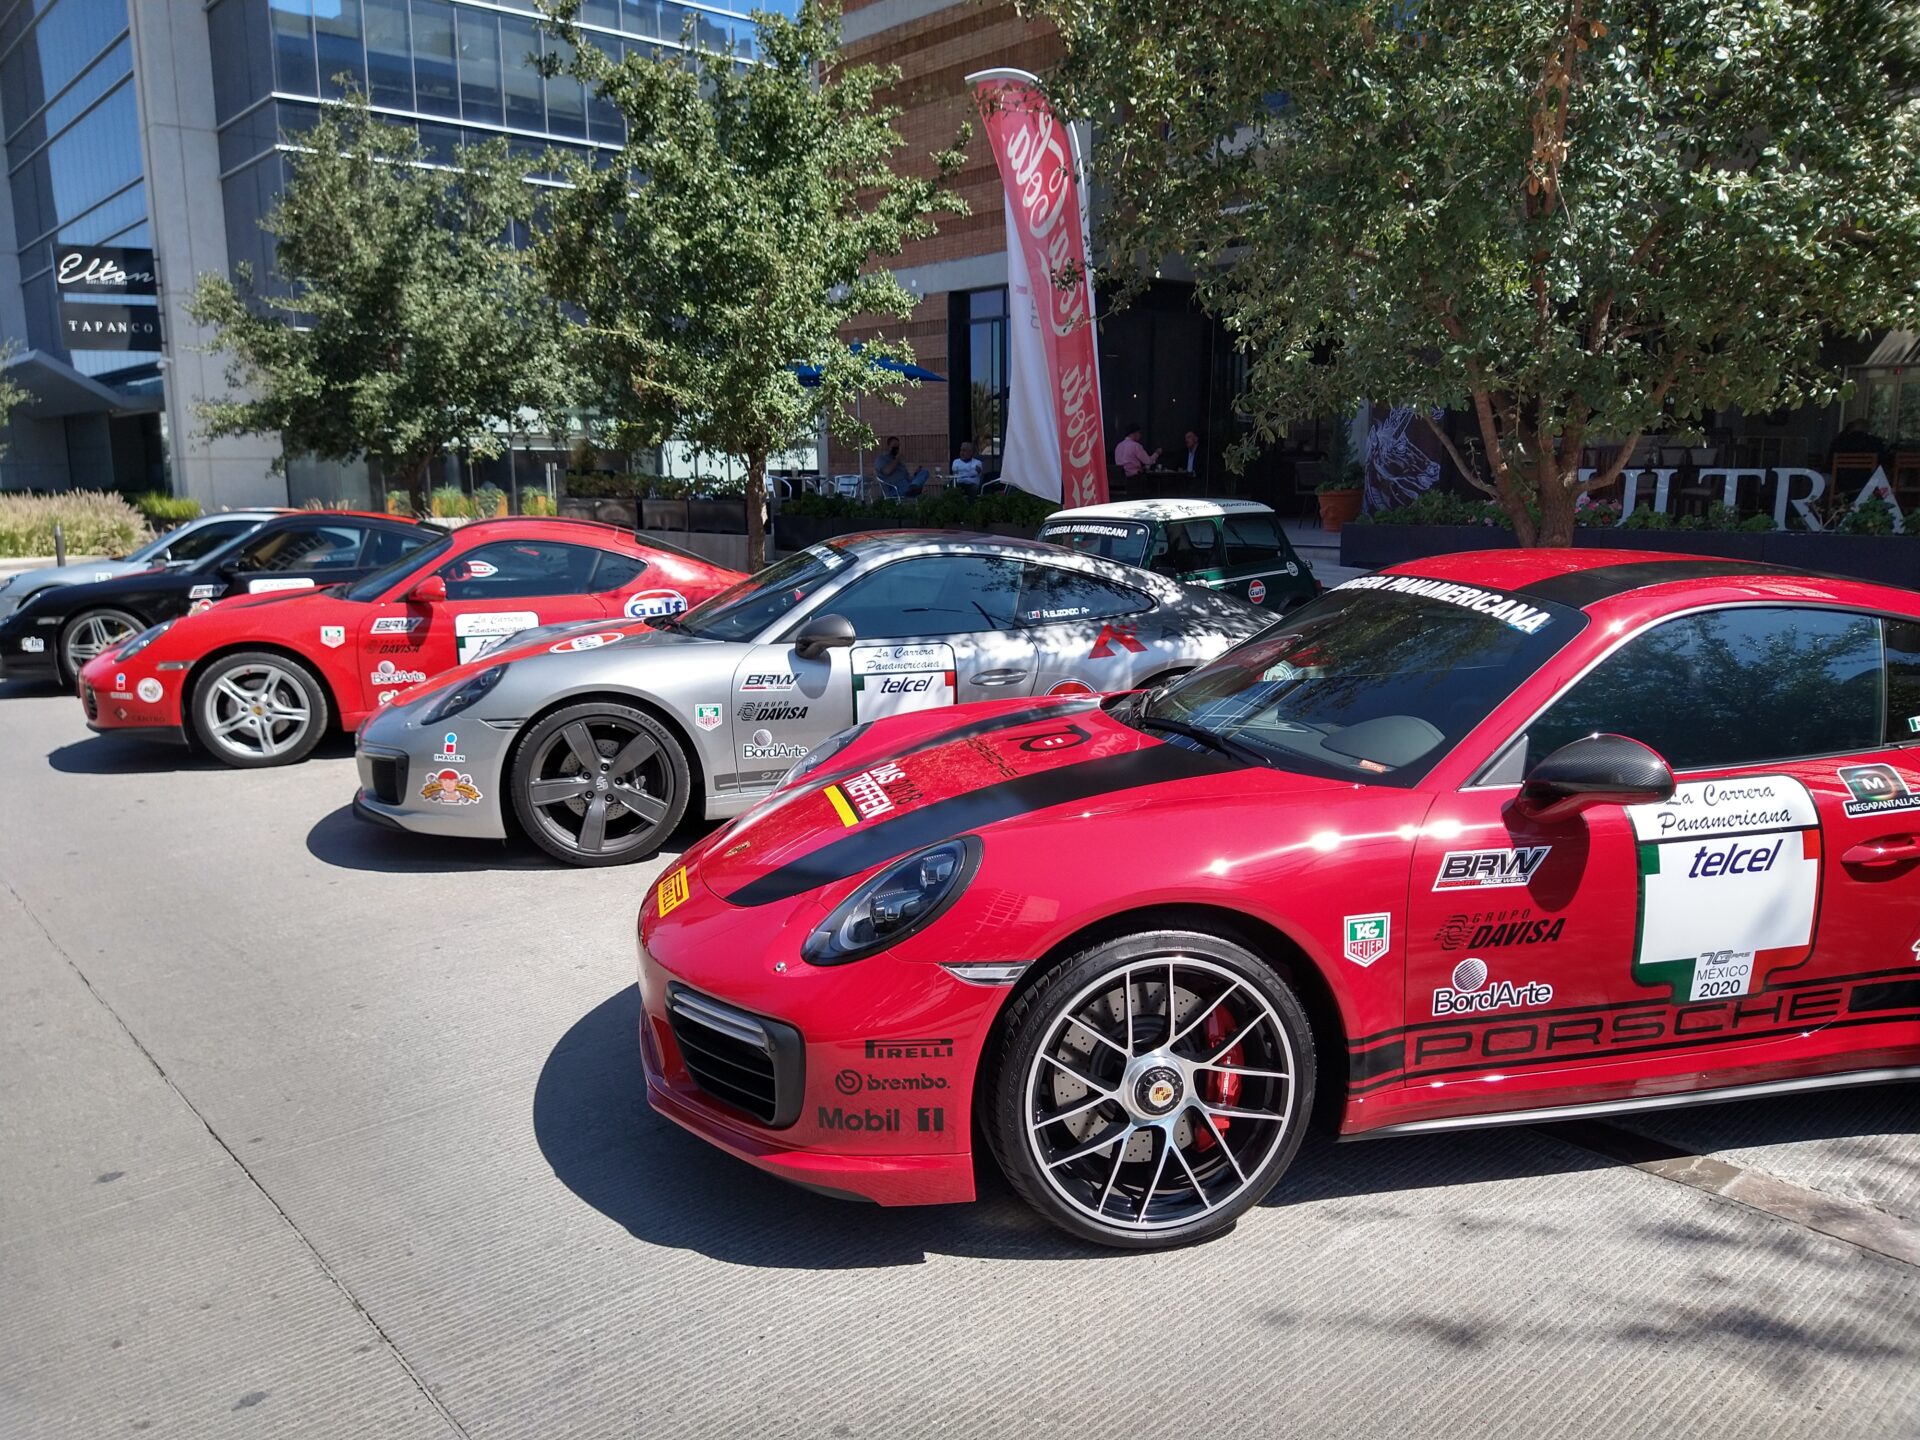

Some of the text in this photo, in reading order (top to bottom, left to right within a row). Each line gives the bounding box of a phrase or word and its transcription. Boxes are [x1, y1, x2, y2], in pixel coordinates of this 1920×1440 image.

[58, 253, 154, 284] Elton
[68, 320, 153, 334] TAPANCO
[1045, 525, 1128, 538] CARRERA PANAMERICANA
[1250, 587, 1265, 596] Gulf
[631, 601, 683, 618] Gulf
[1380, 578, 1550, 634] PANAMERICANA
[380, 643, 420, 654] DAVISA
[873, 647, 935, 659] La Carrera
[866, 660, 940, 672] Panamericana
[373, 671, 426, 684] BordArte
[745, 673, 803, 685] BRW
[880, 675, 934, 694] telcel
[755, 706, 809, 721] DAVISA
[744, 744, 808, 758] BordArte
[869, 762, 923, 805] DAS 2018
[1861, 776, 1885, 790] M
[842, 772, 895, 819] TREFFEN
[1664, 783, 1775, 806] La Carrera
[1848, 797, 1920, 813] MEGAPANTALLAS
[1657, 808, 1792, 836] Panamericana
[1442, 849, 1546, 879] BRW
[1688, 838, 1784, 878] telcel
[1472, 908, 1531, 923] GRUPO
[1354, 922, 1380, 939] TAG
[1467, 918, 1566, 950] DAVISA
[1351, 939, 1382, 959] HEUER
[1700, 950, 1733, 966] 70
[1696, 964, 1749, 981] MÉXICO
[1699, 979, 1741, 998] 2020
[1434, 983, 1552, 1014] BordArte
[1415, 987, 1843, 1066] PORSCHE
[865, 1038, 953, 1059] PIRELLI
[818, 1105, 945, 1132] Mobil 1
